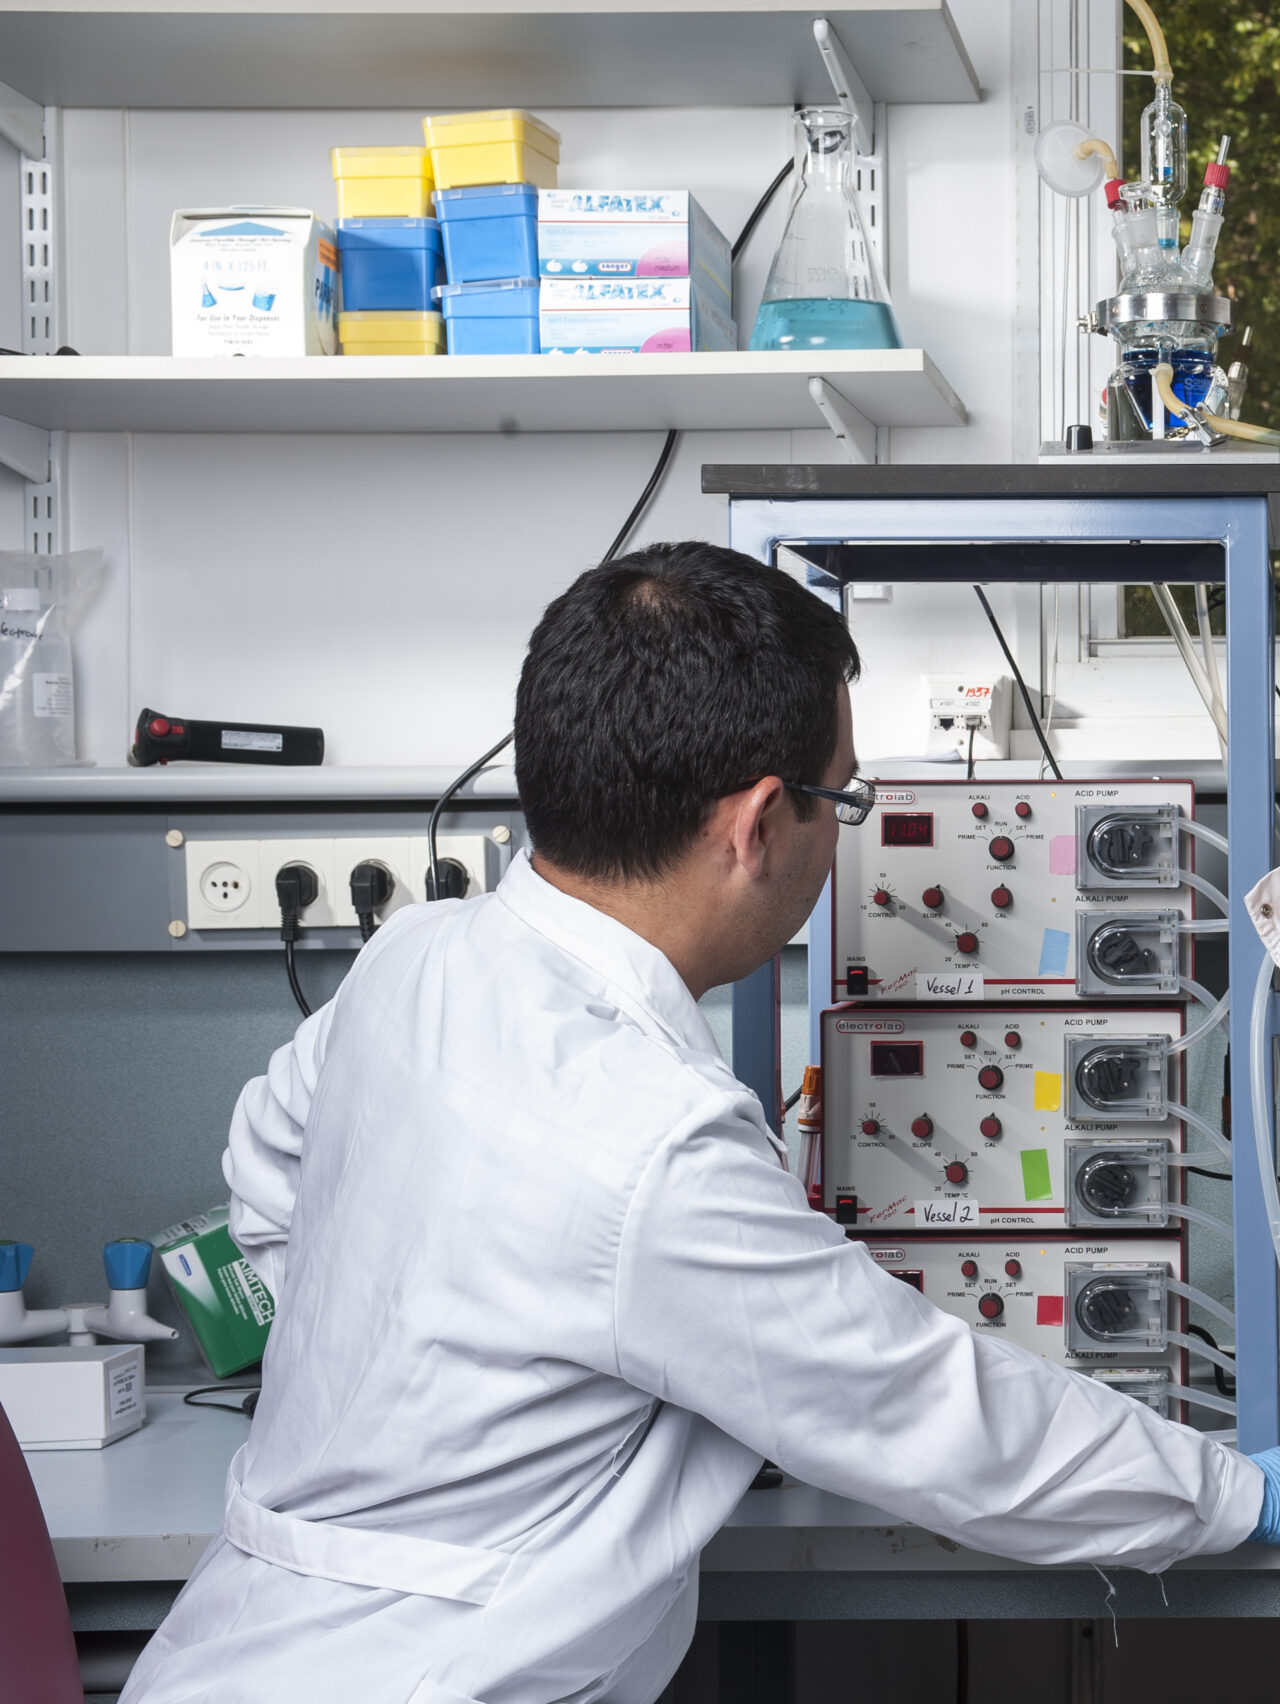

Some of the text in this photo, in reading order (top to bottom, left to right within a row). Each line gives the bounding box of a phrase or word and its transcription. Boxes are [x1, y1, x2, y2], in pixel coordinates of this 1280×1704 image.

[875, 793, 913, 801] trolab
[927, 977, 962, 994] Vessel
[838, 1022, 903, 1030] electrolab
[924, 1202, 974, 1223] Vessel 2
